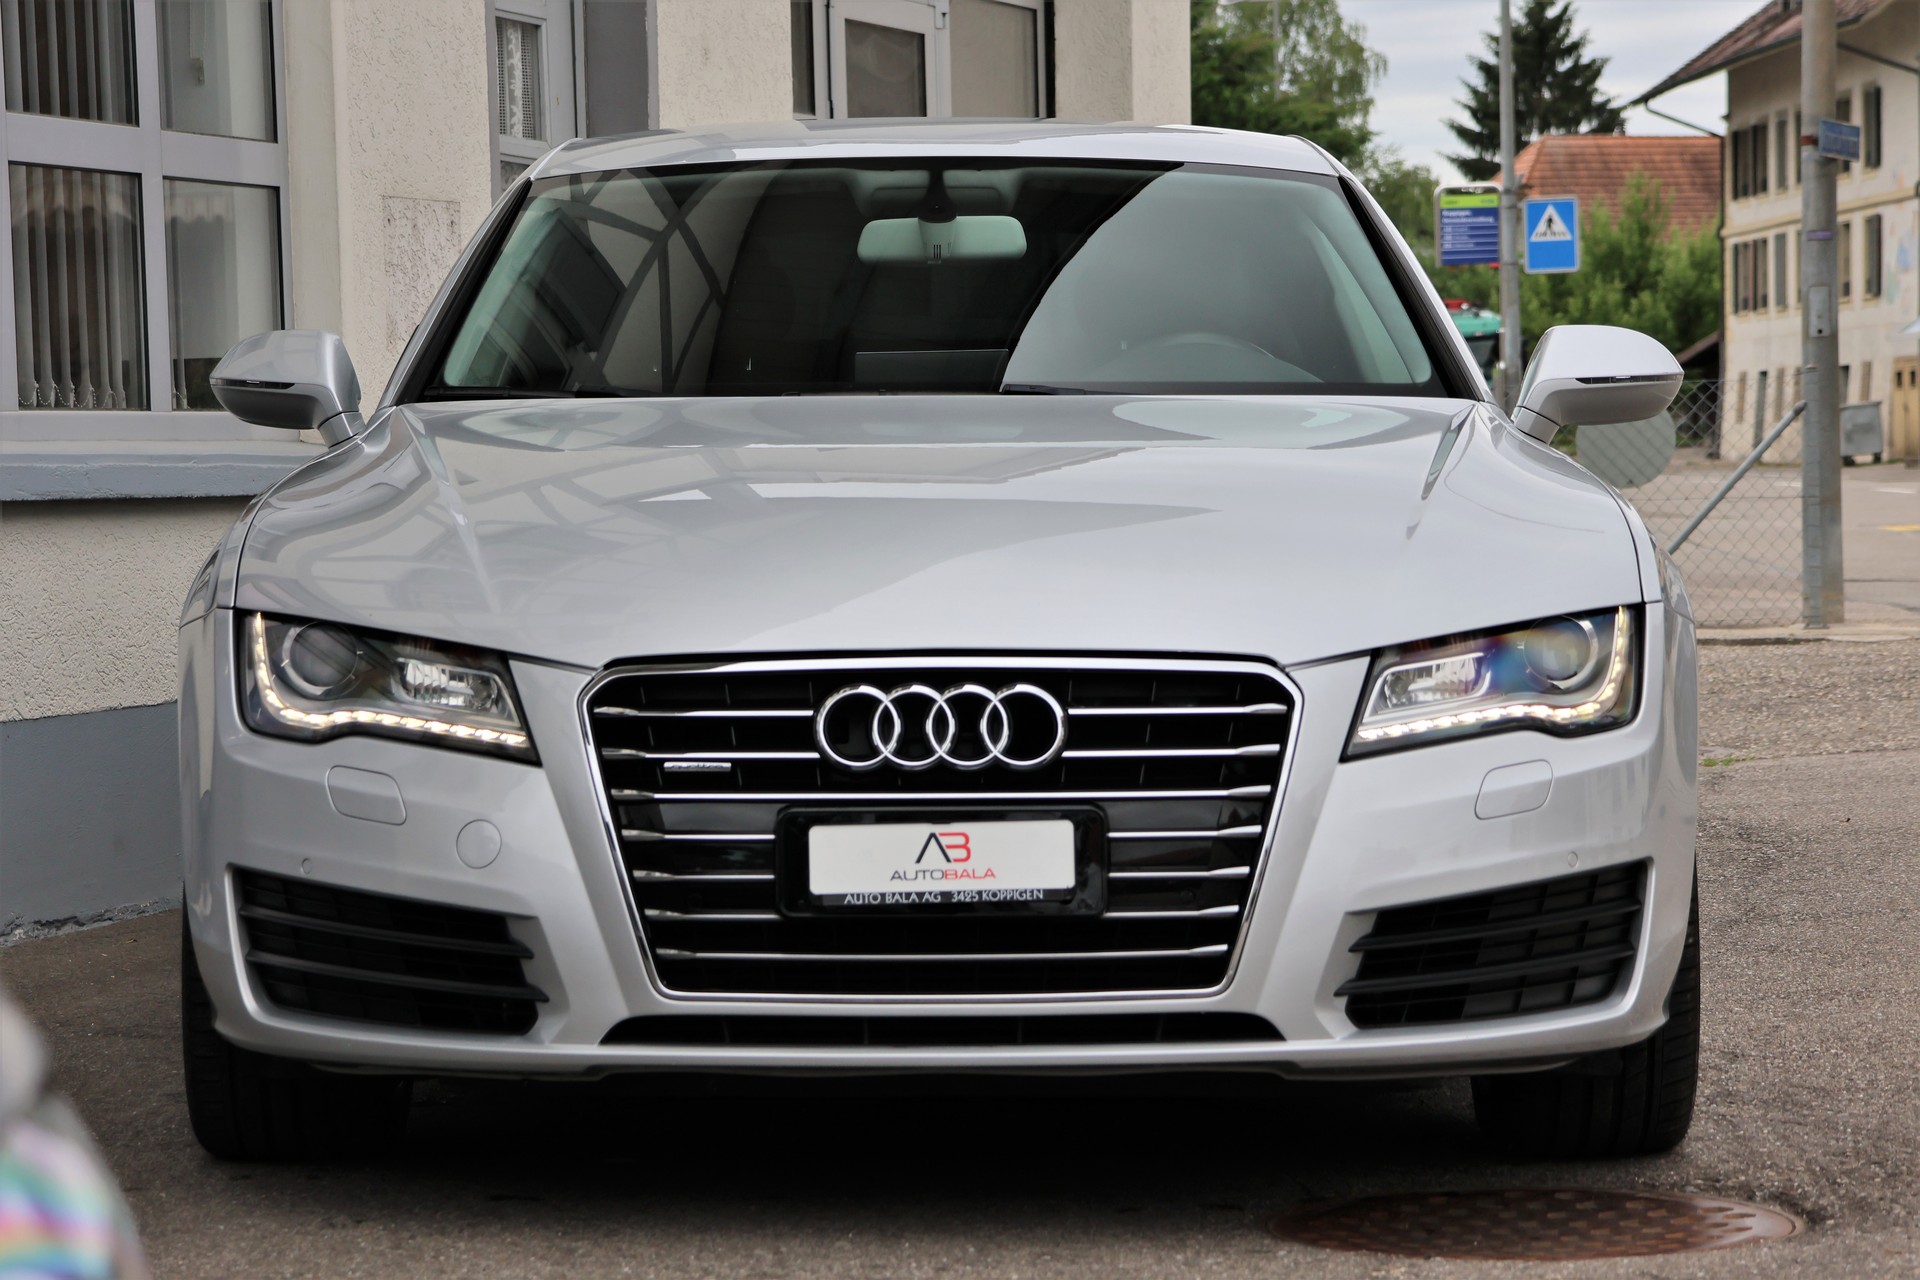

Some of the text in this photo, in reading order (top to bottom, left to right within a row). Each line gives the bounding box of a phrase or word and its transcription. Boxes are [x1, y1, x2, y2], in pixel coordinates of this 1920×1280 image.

[915, 832, 971, 864] AB
[890, 868, 996, 881] AUTOBALA
[844, 888, 1043, 904] AUTO BALA AG 3425 KOPPIGEN
